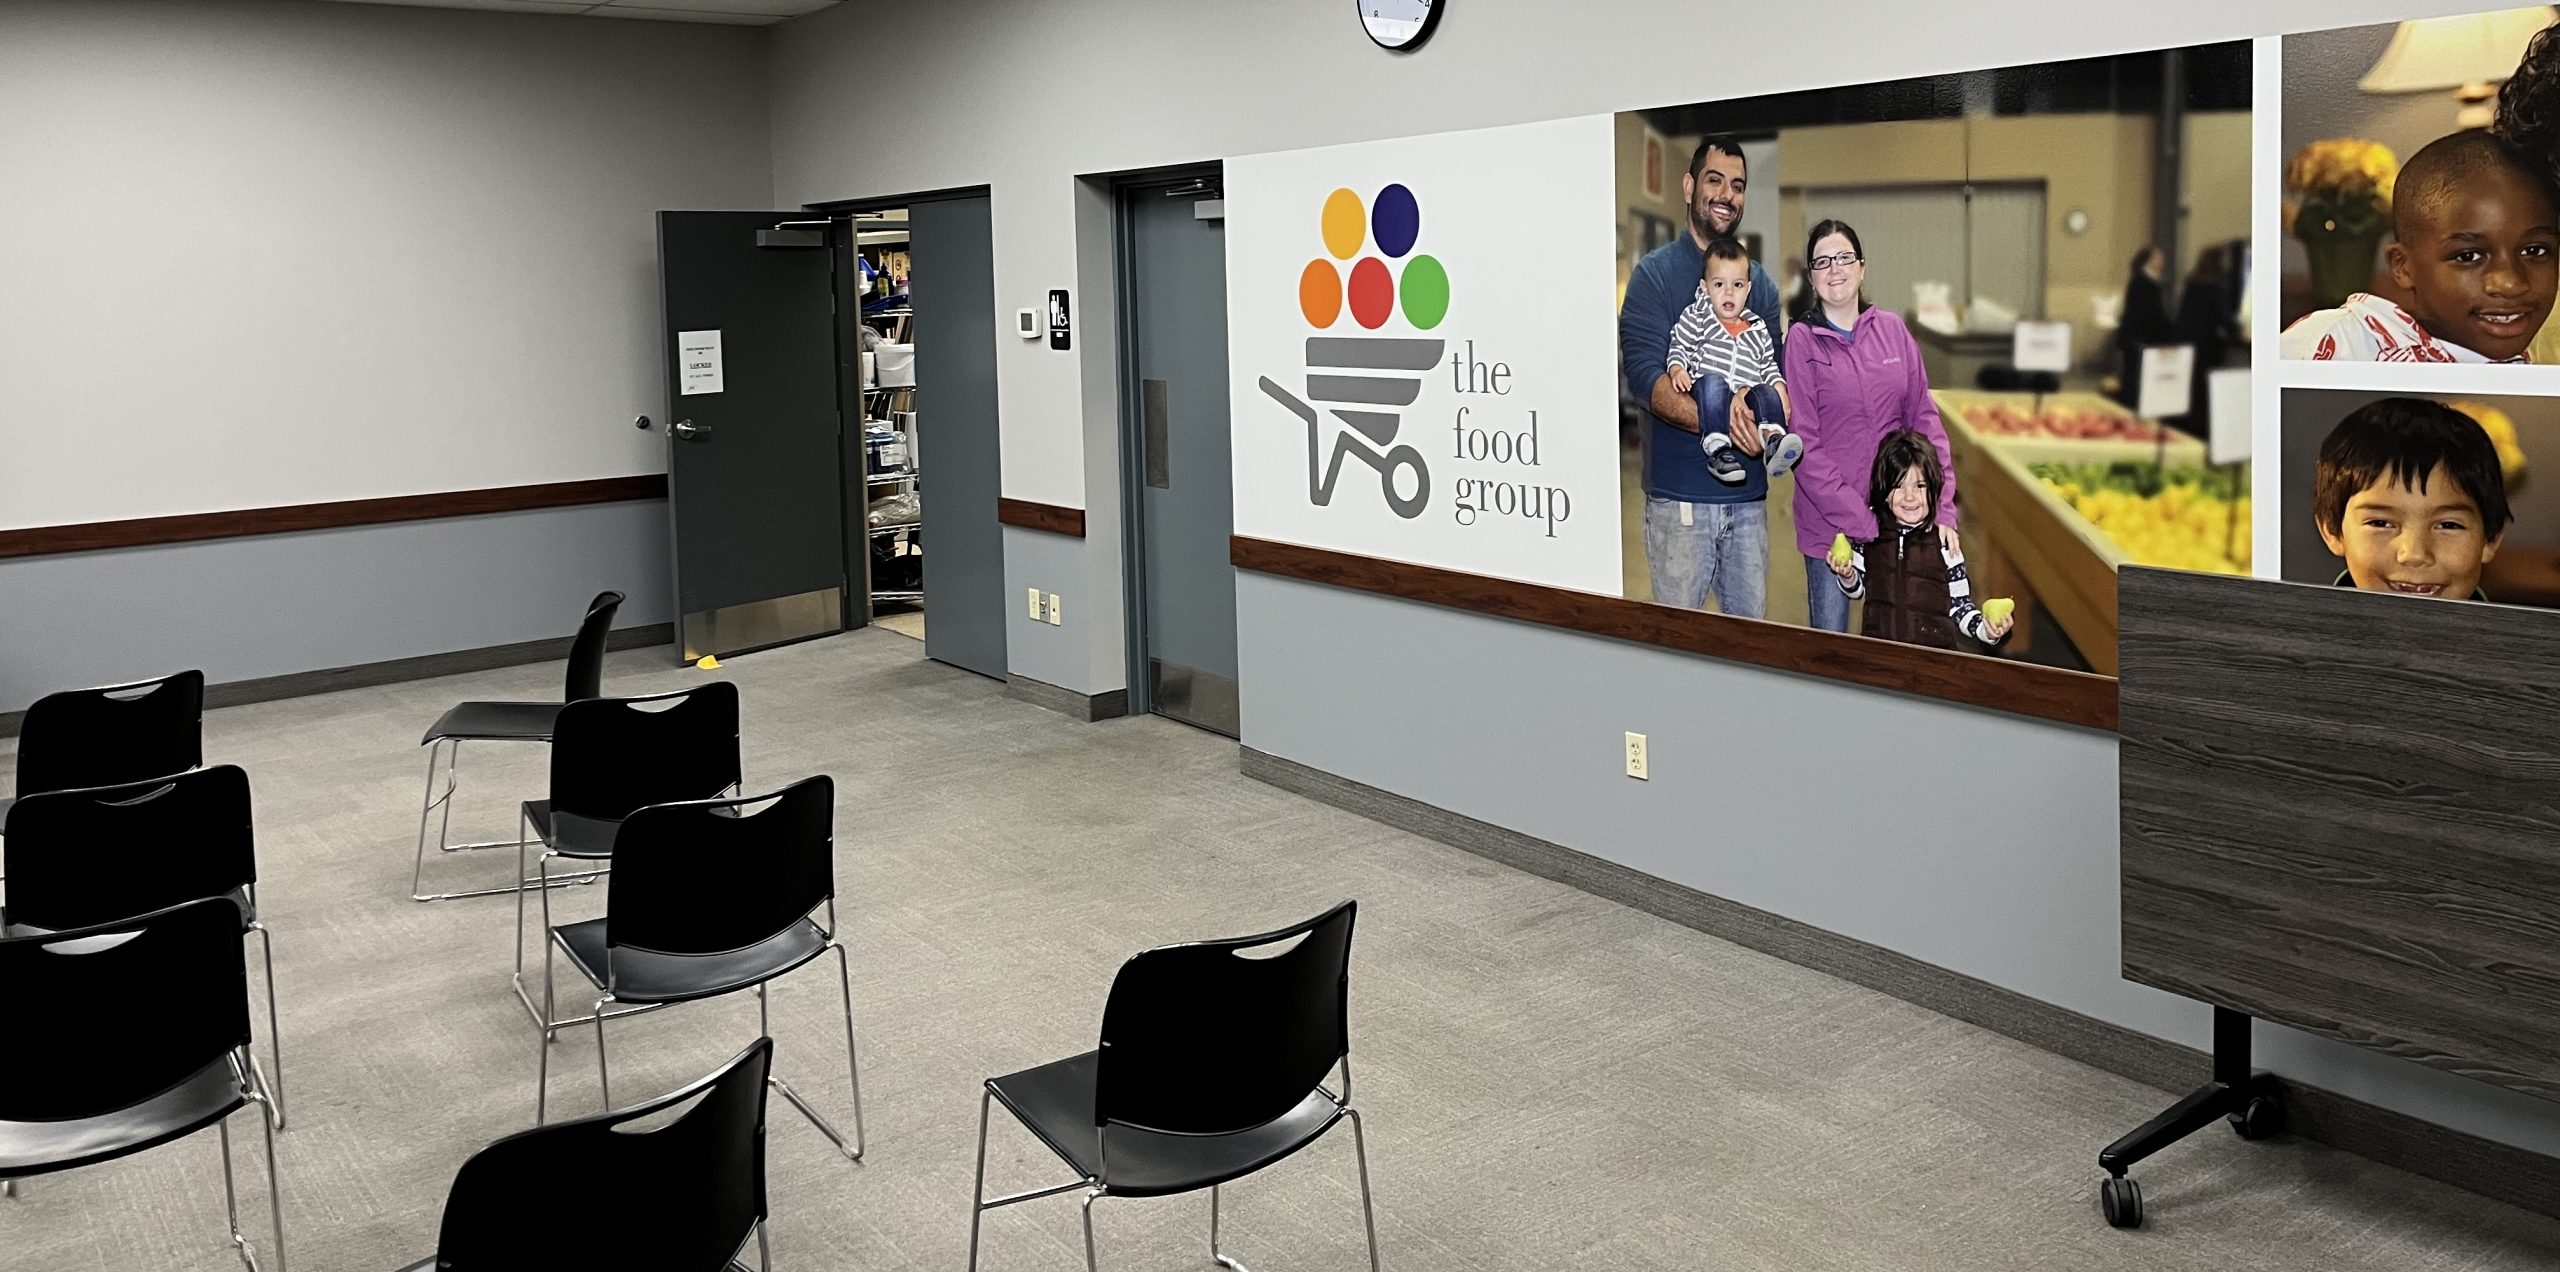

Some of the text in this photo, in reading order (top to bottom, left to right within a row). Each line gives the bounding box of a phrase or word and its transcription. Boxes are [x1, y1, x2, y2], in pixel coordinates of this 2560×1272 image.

[1451, 340, 1512, 395] the
[1453, 406, 1541, 466] food
[1455, 477, 1571, 538] group
